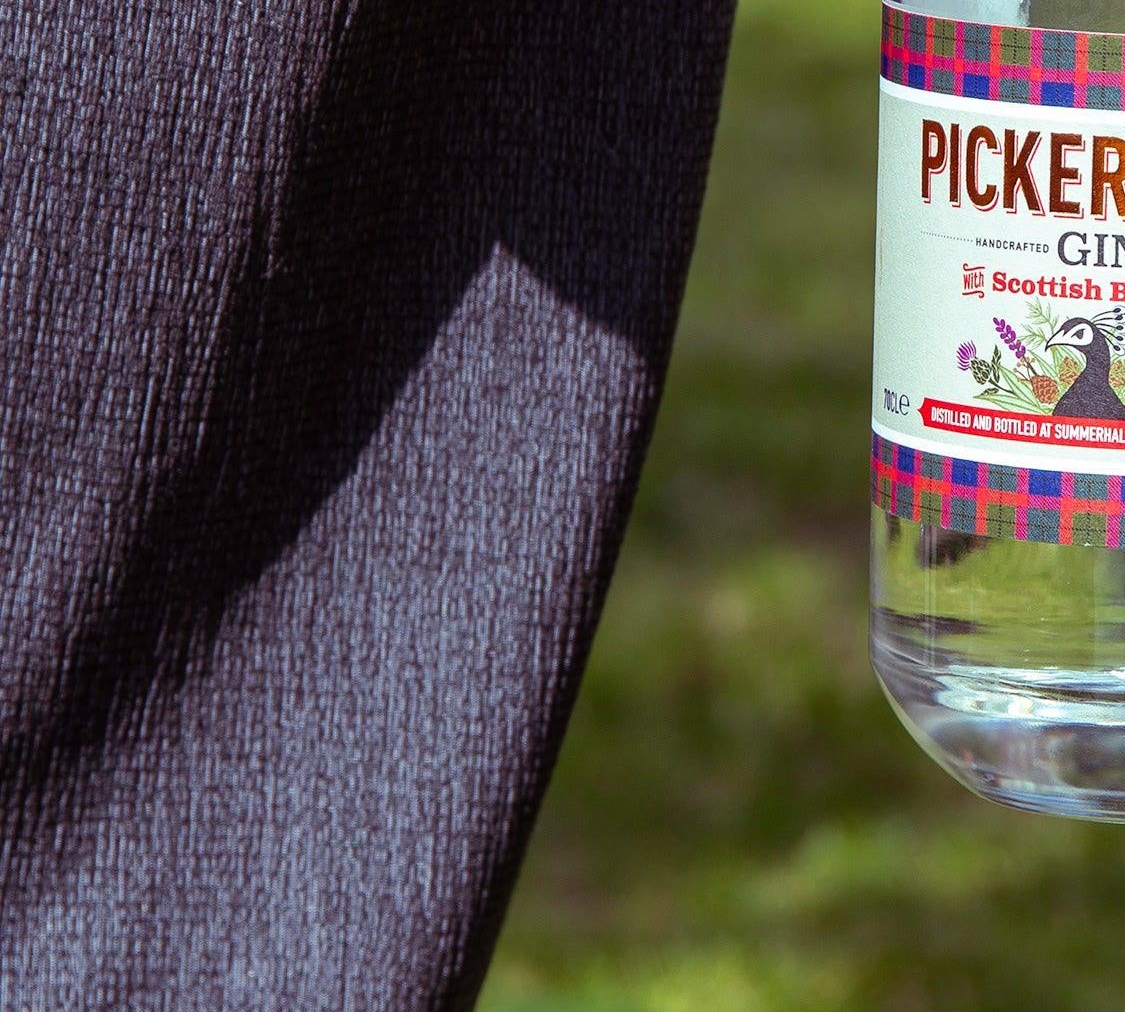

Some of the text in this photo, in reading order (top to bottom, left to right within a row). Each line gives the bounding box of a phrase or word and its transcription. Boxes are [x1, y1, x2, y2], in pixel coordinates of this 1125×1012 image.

[975, 237, 1050, 253] HANDCRAFTED
[991, 271, 1102, 301] Scottish
[931, 406, 971, 429] DISTILLED
[972, 412, 993, 431] AND
[994, 415, 1037, 437] BOTTLED
[1039, 422, 1053, 438] AT
